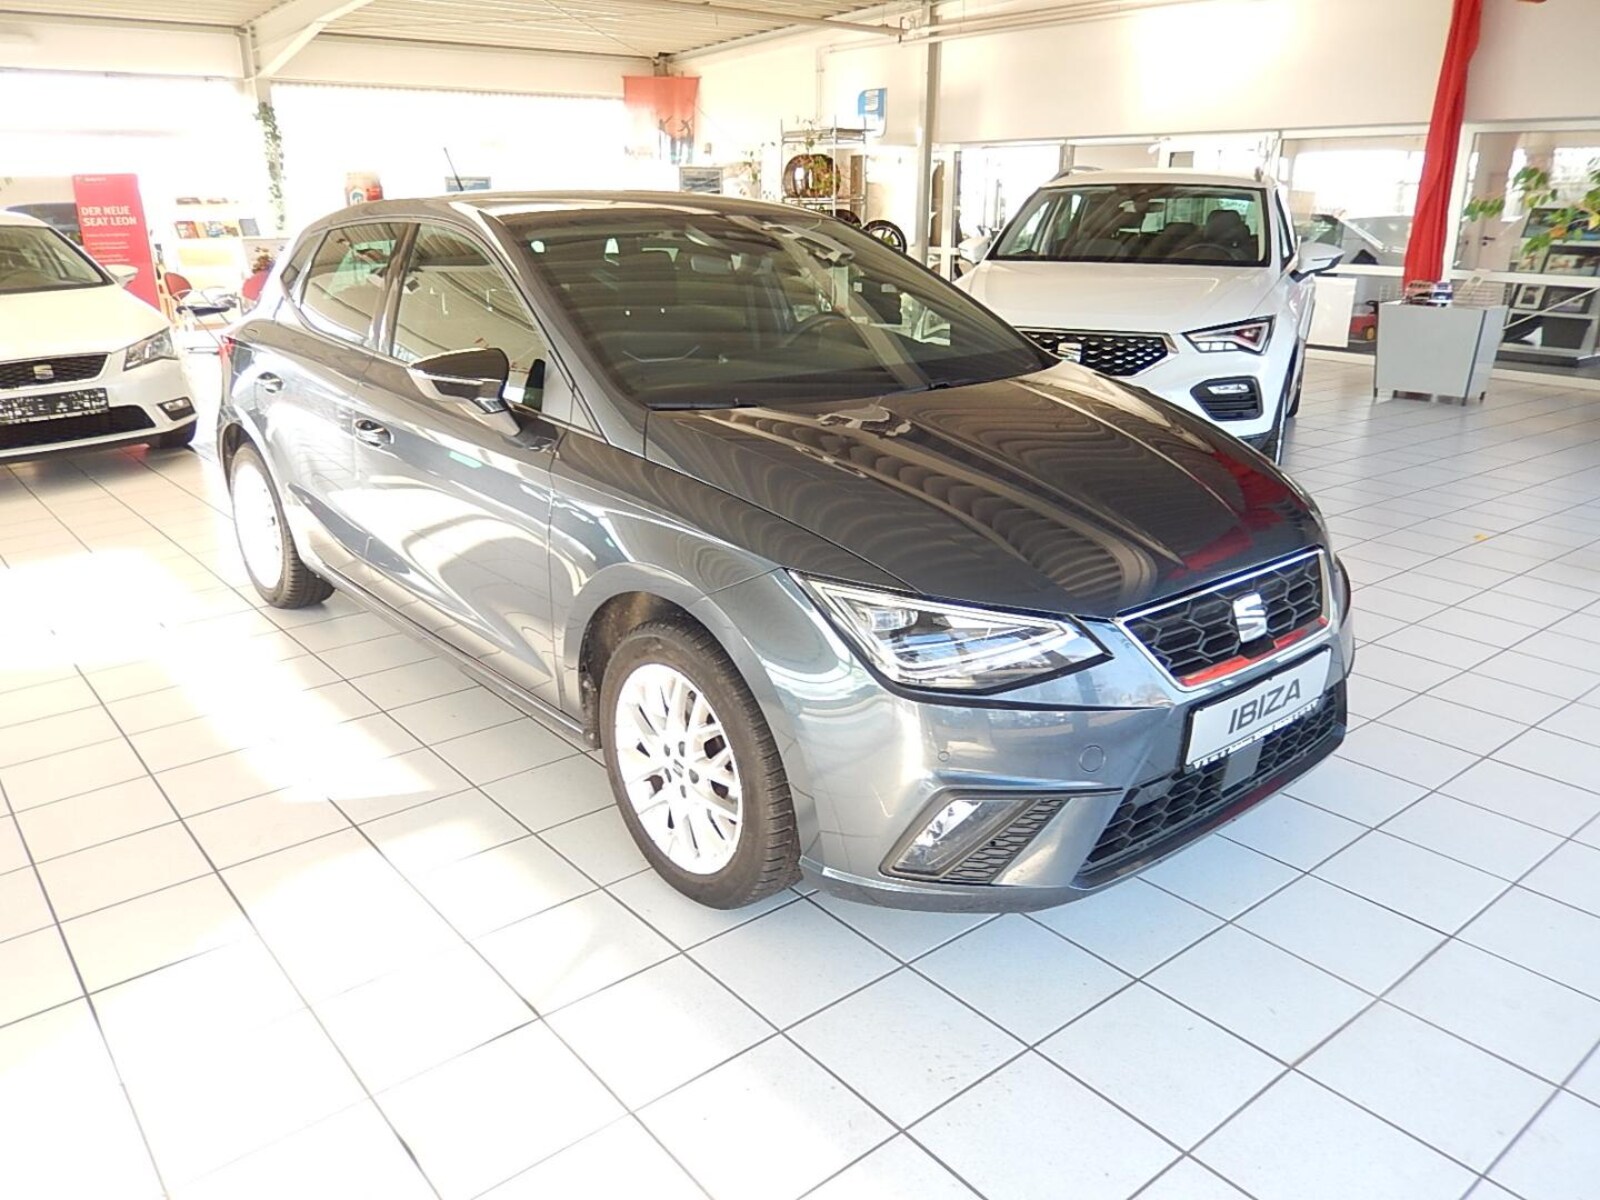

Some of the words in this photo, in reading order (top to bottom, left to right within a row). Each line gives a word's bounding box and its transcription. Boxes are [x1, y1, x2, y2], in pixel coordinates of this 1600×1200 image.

[81, 206, 102, 216] DER
[103, 205, 131, 215] NEUE
[83, 217, 108, 227] SEAT
[110, 216, 137, 226] LEON
[1228, 679, 1301, 734] IBIZA
